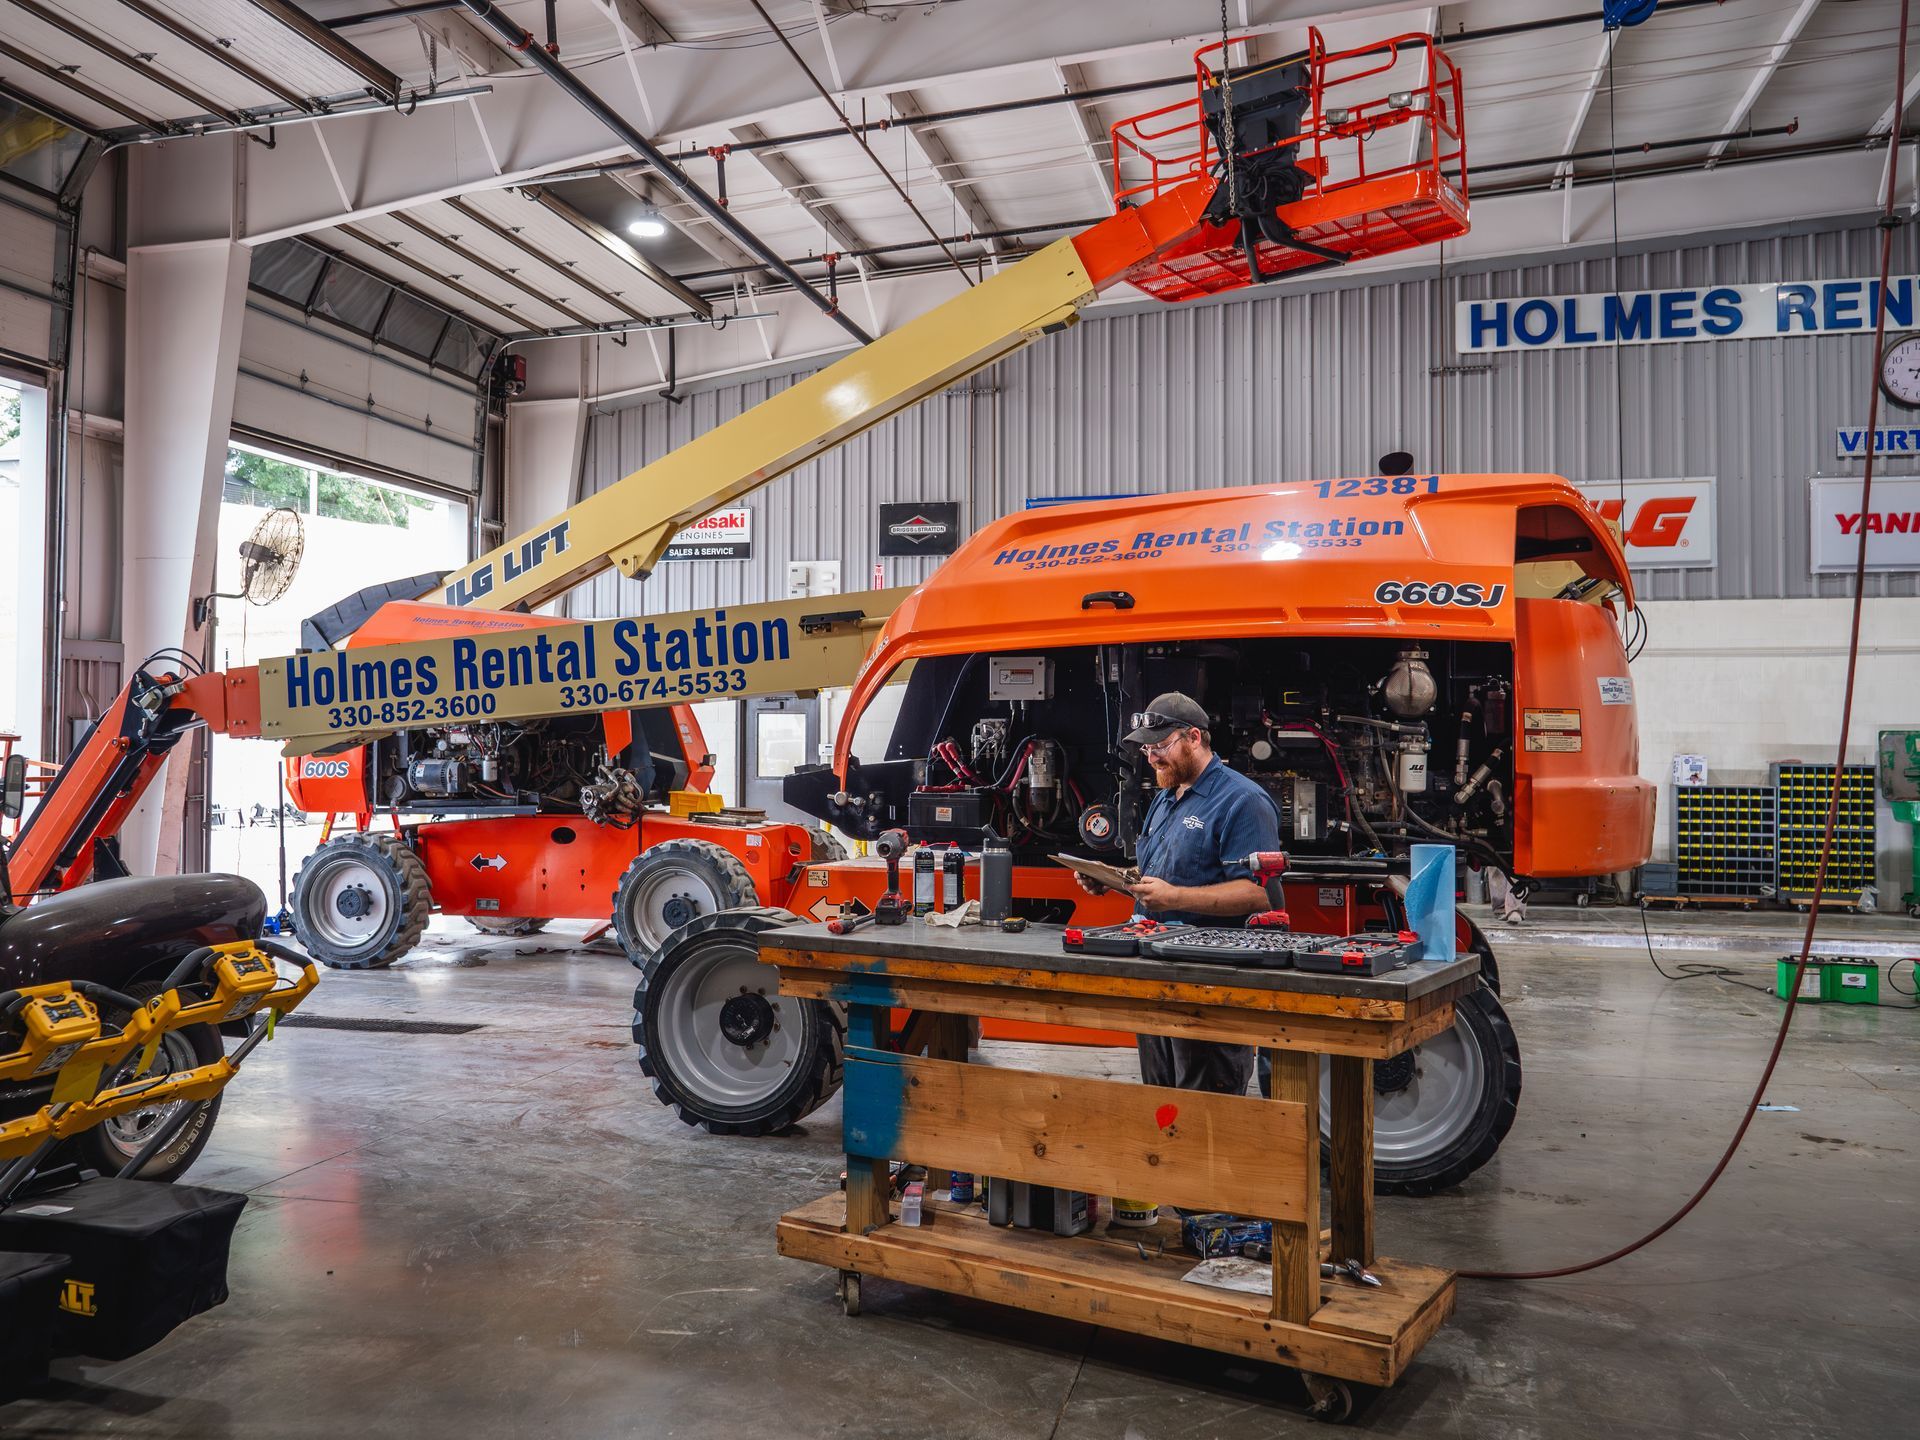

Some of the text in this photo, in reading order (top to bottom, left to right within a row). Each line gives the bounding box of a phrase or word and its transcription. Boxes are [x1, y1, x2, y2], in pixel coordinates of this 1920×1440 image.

[1470, 279, 1920, 348] HOLMES REN
[1313, 475, 1439, 499] 12381
[680, 531, 723, 540] ENGINES
[691, 513, 745, 529] asaki
[503, 518, 571, 584] LIFT
[669, 547, 734, 557] SALES & SERVICE
[993, 516, 1404, 566] Holmes Rental Station
[1022, 537, 1362, 571] 330-852-3600 330--5533
[1374, 580, 1506, 607] 660SJ
[286, 651, 438, 708] Holmes
[452, 624, 596, 692] Rental
[613, 610, 790, 677] Station
[328, 668, 747, 729] 330-852-3600 330-674-5533
[304, 760, 350, 778] 600S
